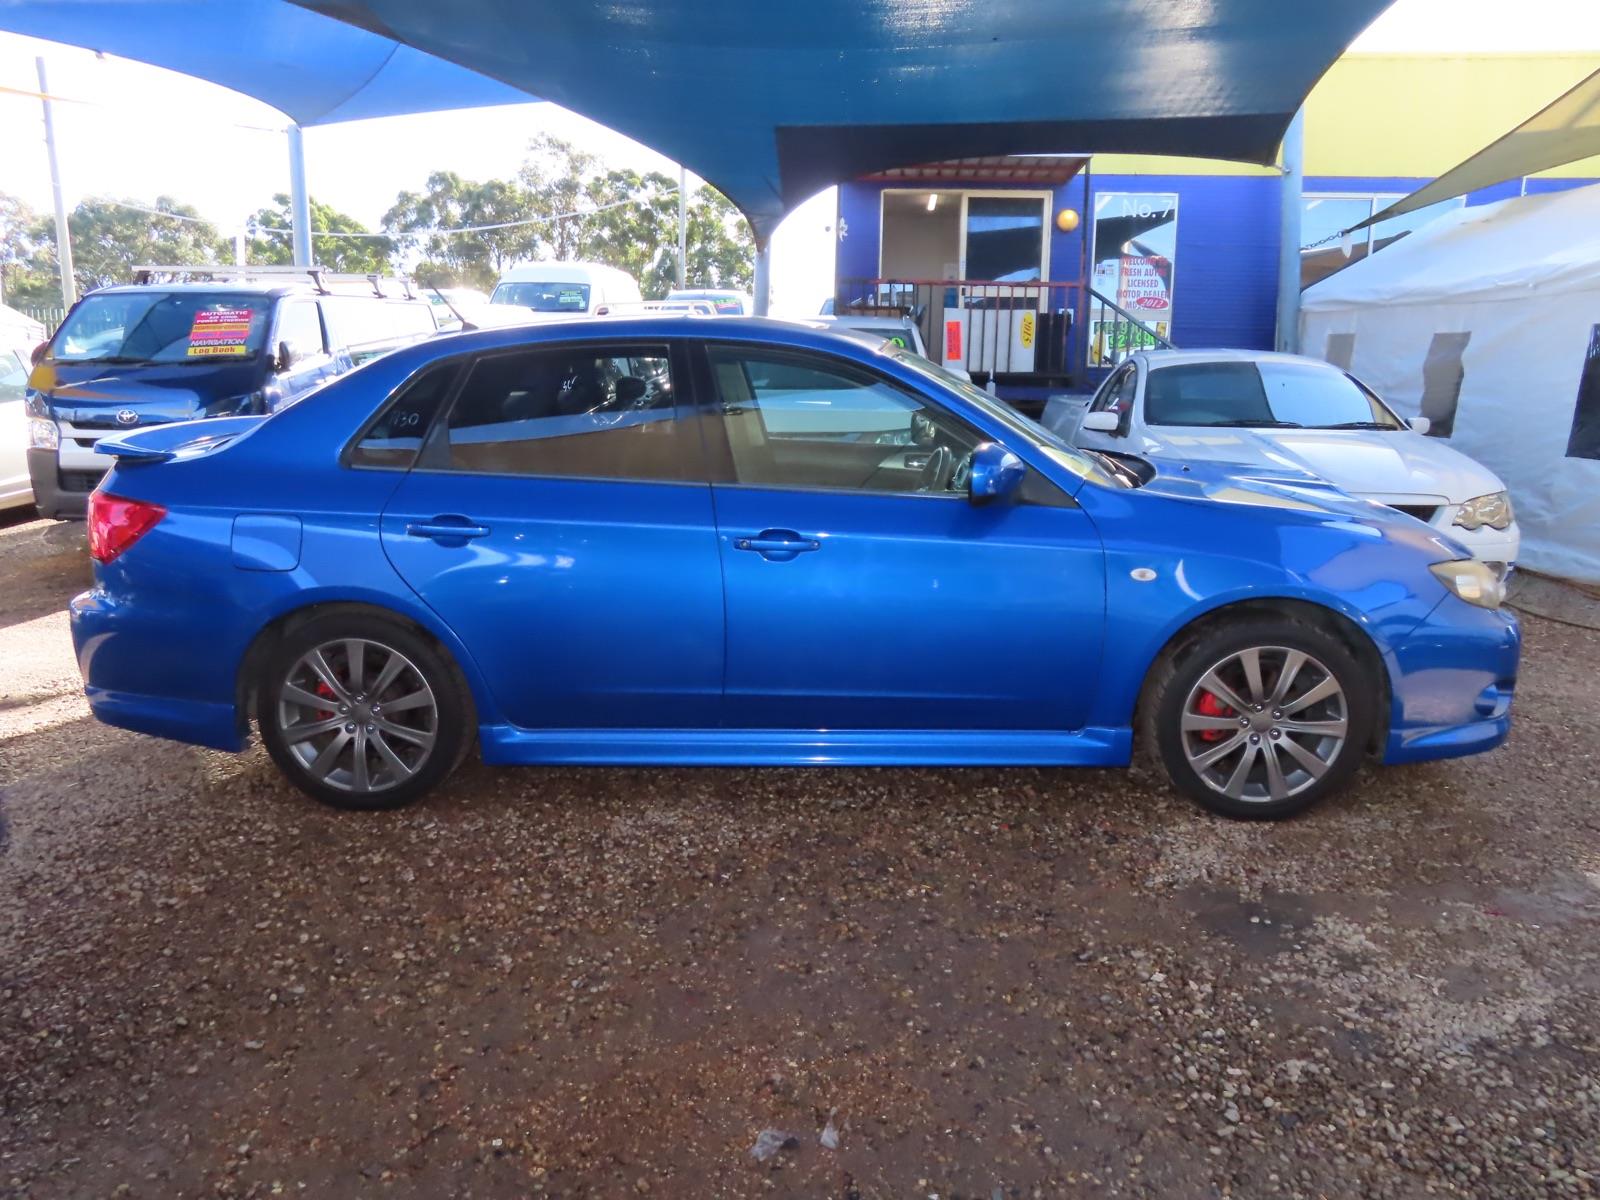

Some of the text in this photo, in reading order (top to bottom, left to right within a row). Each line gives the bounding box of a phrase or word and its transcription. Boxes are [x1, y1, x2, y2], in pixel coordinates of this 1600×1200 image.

[1120, 267, 1142, 277] FRESH
[1127, 279, 1159, 288] LICENSED
[1116, 290, 1141, 298] MOTOR
[190, 338, 246, 346] NAVIGATION
